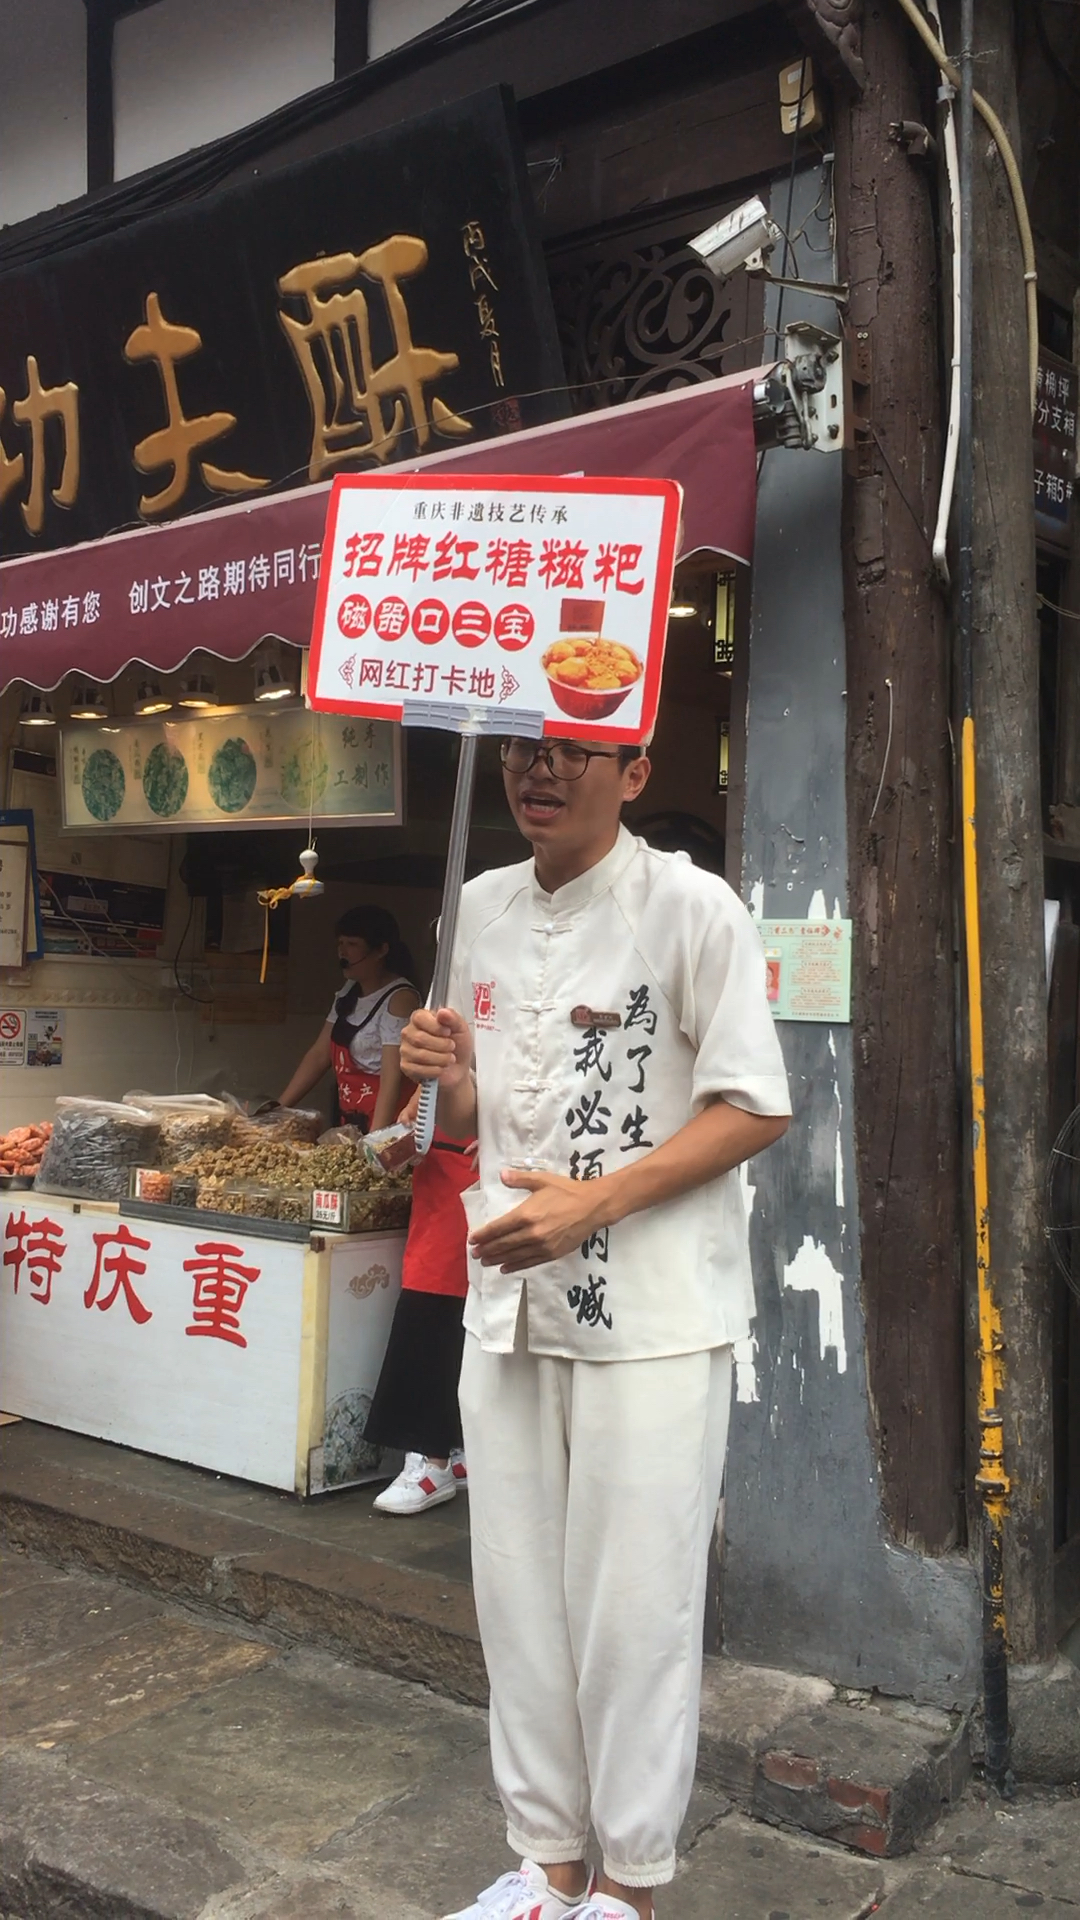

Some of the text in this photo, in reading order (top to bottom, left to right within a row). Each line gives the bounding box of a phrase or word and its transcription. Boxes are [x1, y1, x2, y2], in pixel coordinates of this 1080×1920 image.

[412, 501, 569, 523] 重庆非遗技艺传承
[342, 530, 645, 595] 招牌红糖糍粑
[0, 543, 323, 639] 功感谢有您 创文之路期待同行
[341, 600, 531, 644] 磁器口三宝
[359, 658, 496, 698] 网红打卡地
